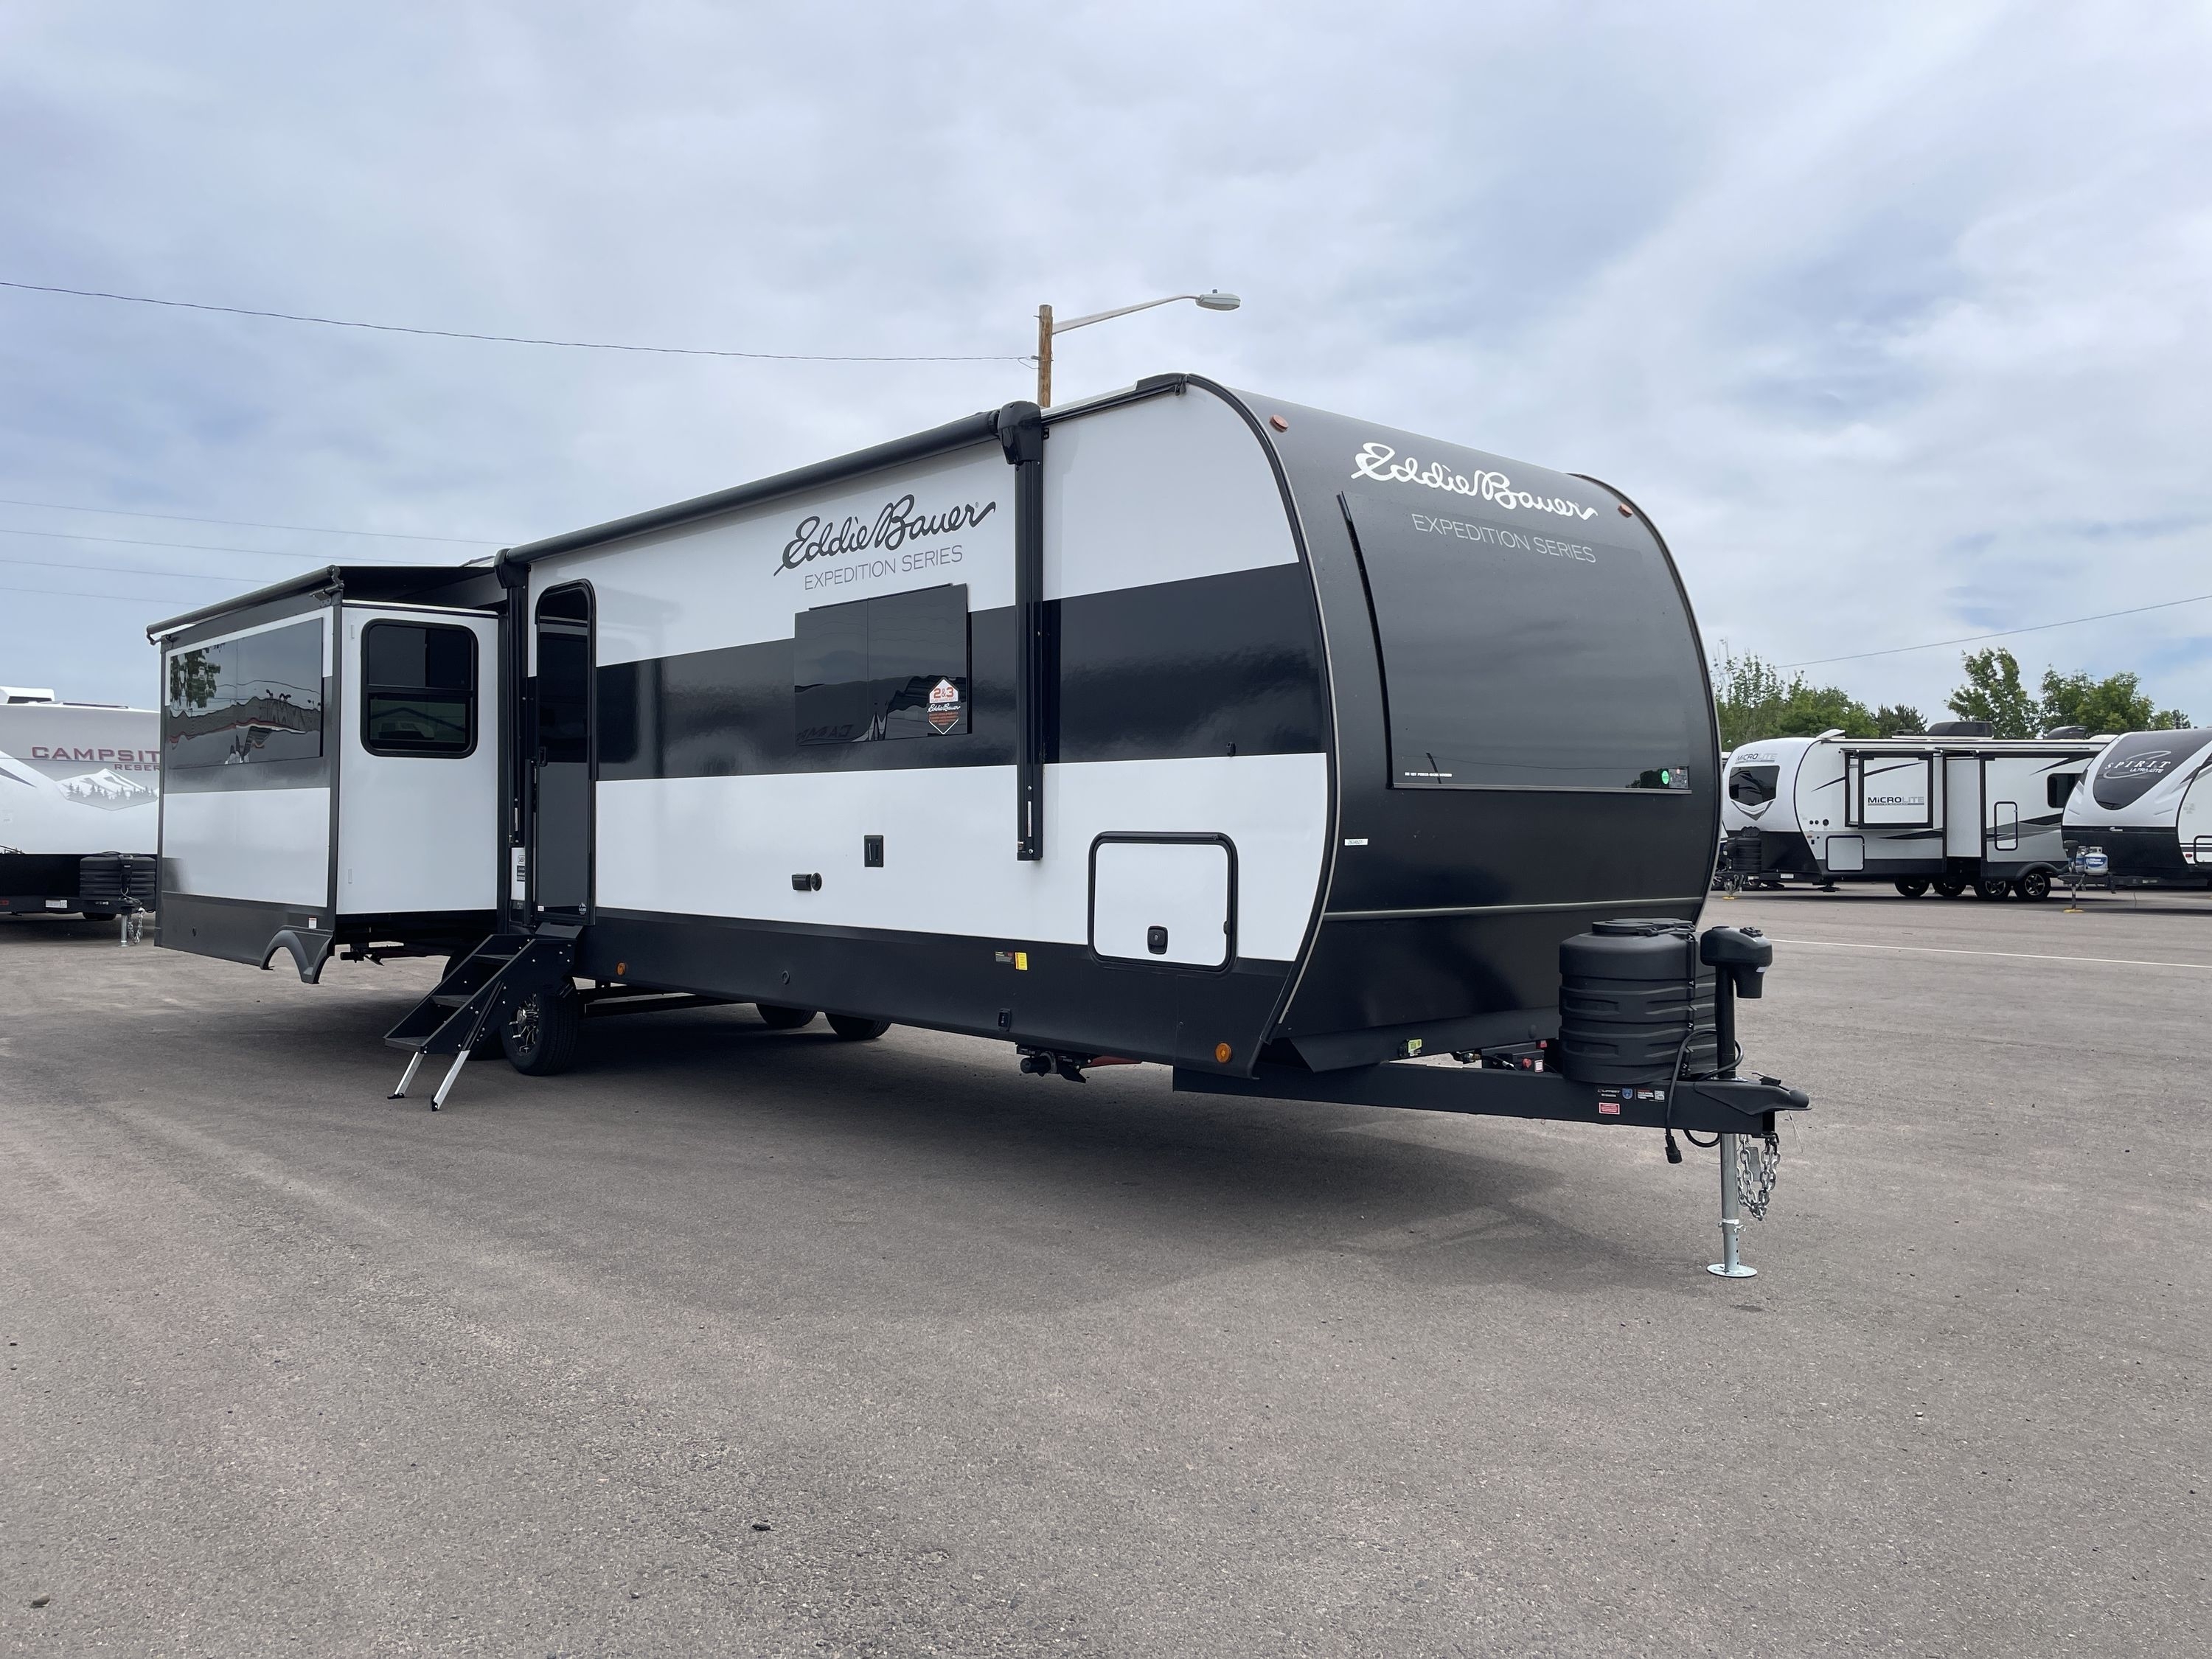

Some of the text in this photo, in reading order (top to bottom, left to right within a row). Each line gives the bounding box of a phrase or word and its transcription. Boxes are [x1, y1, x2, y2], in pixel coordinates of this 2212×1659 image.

[1351, 442, 1599, 521] Eddie Bauer
[773, 494, 996, 577] Eddie Bauer
[1411, 513, 1596, 563] EXPEDITION SERIES
[804, 544, 963, 591] EXPEDITION SERIES
[933, 686, 954, 699] 2&3
[2104, 760, 2171, 770] SPIRIT
